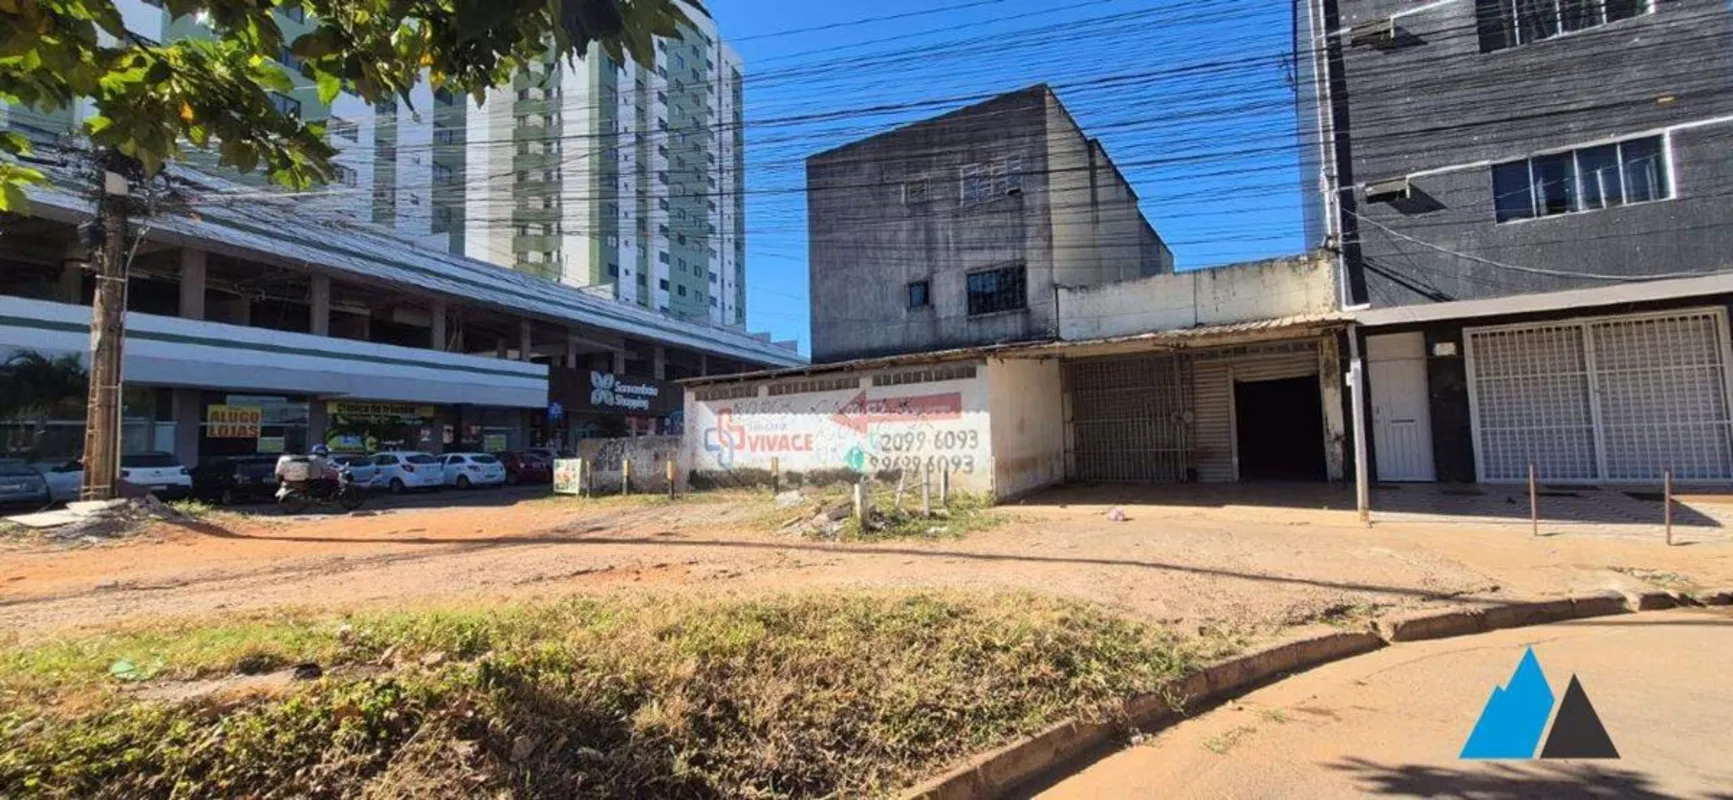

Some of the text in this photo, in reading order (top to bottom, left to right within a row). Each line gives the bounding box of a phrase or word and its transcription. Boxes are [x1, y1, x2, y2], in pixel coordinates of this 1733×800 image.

[210, 411, 259, 424] ALUGO
[208, 425, 257, 438] LOJAS
[748, 433, 813, 452] VIVACE
[880, 428, 979, 452] 2099 6093
